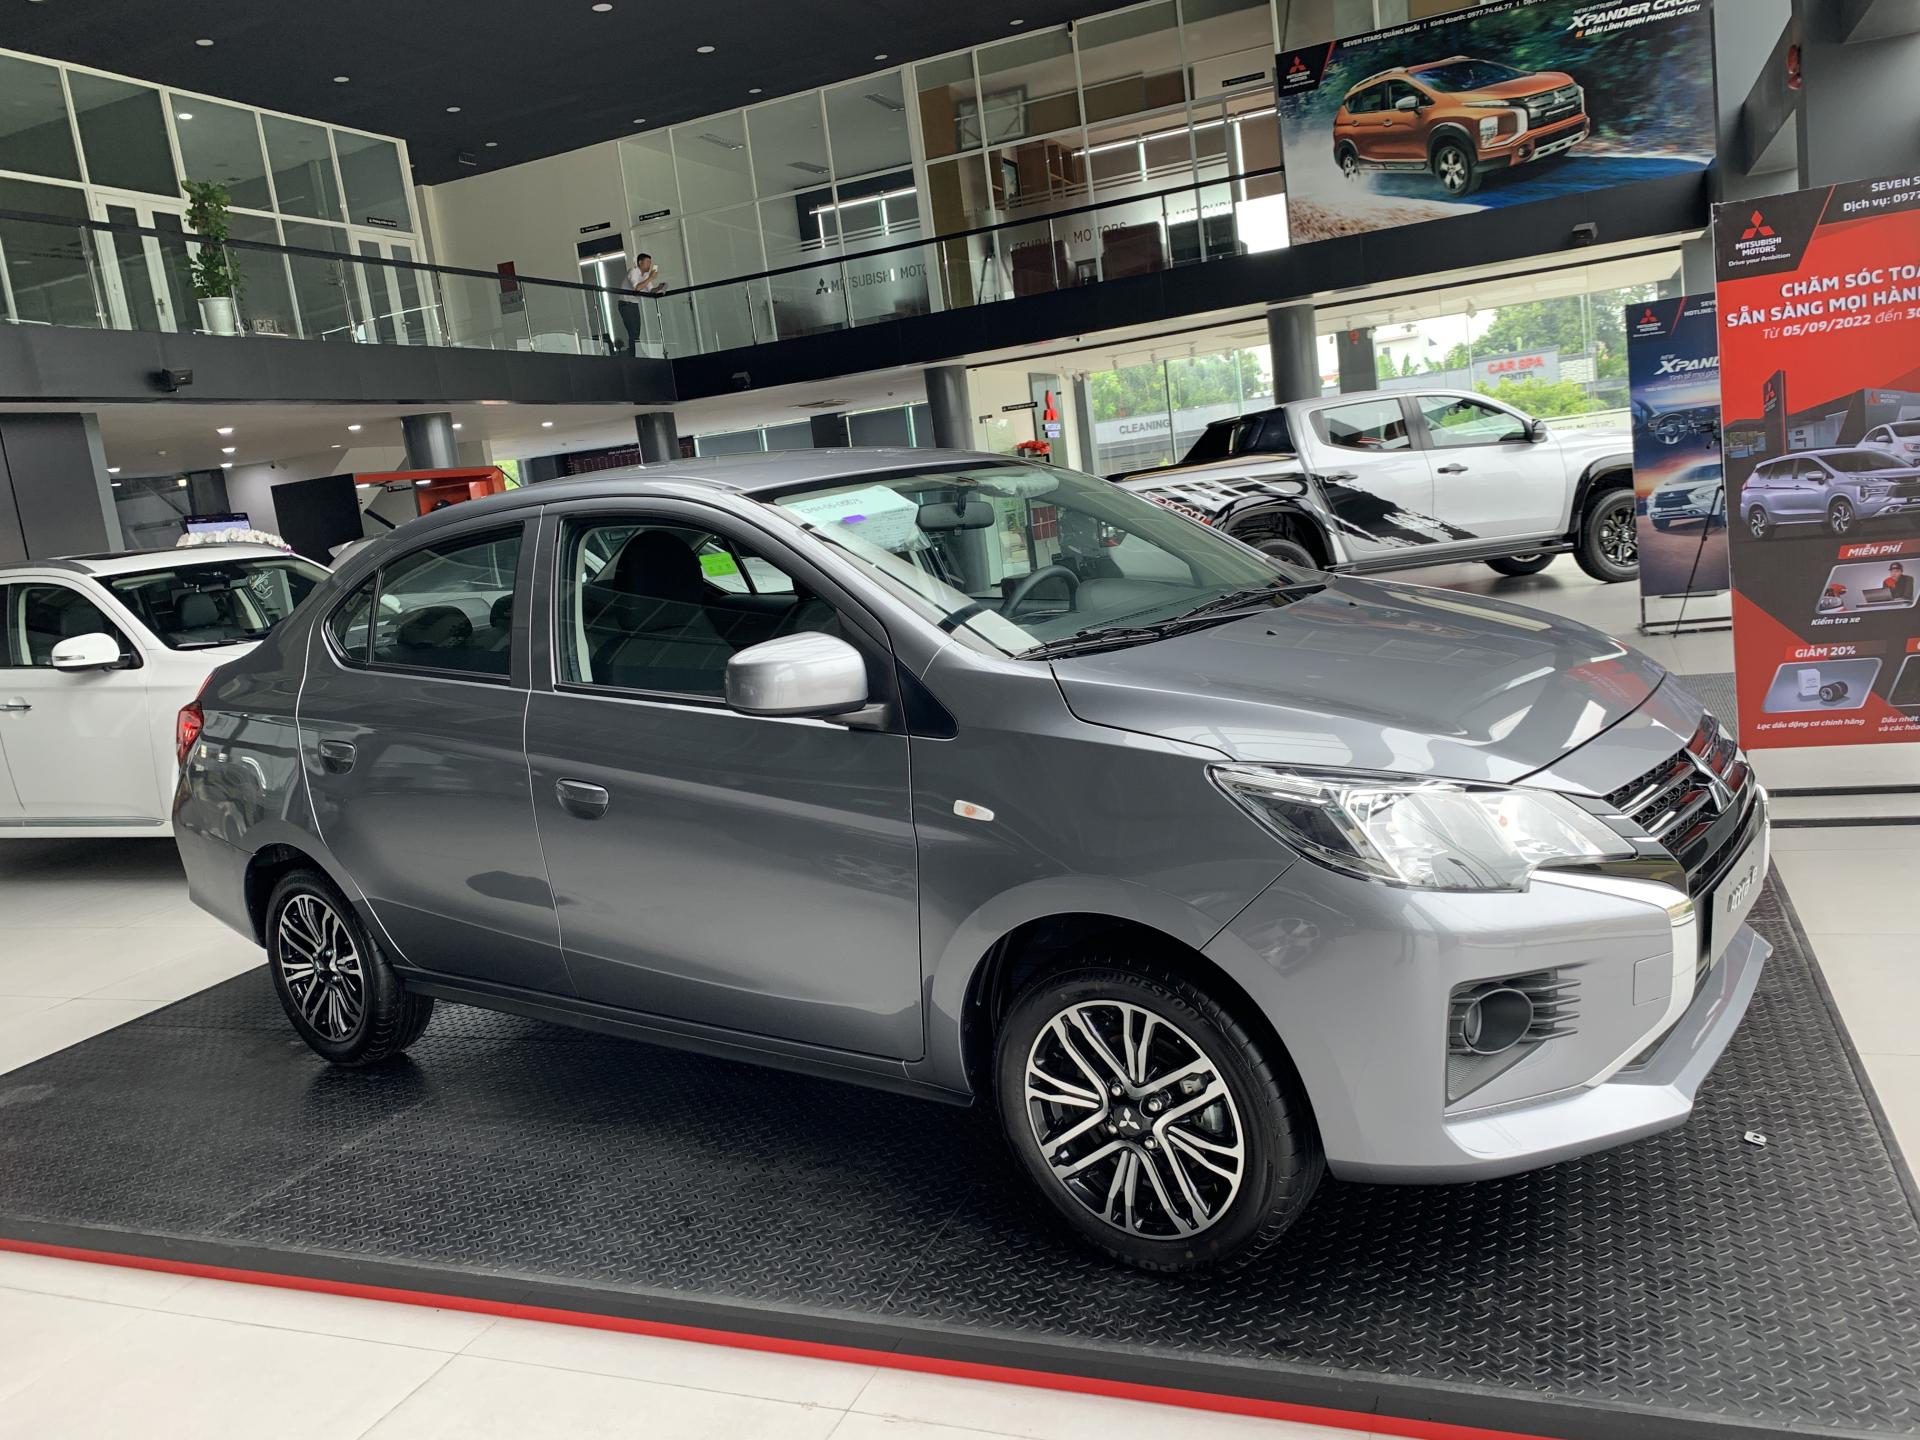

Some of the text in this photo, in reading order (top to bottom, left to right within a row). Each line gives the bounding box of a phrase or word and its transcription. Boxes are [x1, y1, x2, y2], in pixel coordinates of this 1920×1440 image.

[1566, 2, 1651, 31] XPANDER
[1646, 9, 1677, 22] PHONG
[1677, 3, 1702, 16] CÁCH
[1871, 177, 1911, 193] SEVEN
[1843, 199, 1869, 213] Dịch
[1872, 197, 1891, 208] vụ:
[1735, 237, 1782, 250] MITSUBISHI
[1742, 245, 1777, 256] MOTORS
[1728, 252, 1791, 267] Drive your Ambition
[1780, 276, 1839, 298] CHĂM
[1845, 267, 1884, 289] SÓC
[1725, 305, 1766, 328] SẴN
[1770, 300, 1824, 321] SÀNG
[1829, 293, 1867, 313] MỌI
[1762, 328, 1779, 340] Từ
[1783, 314, 1872, 338] 05/09/2022
[1875, 308, 1903, 324] đến
[1488, 356, 1544, 375] CAR SPA
[1119, 418, 1171, 435] CLEANING
[1847, 541, 1904, 558] MIỄN PHÍ
[1810, 616, 1861, 626] Kiểm tra xe
[1795, 644, 1857, 659] GIẢM 20%
[1756, 722, 1772, 731] Lọc
[1787, 720, 1809, 731] động
[1820, 718, 1843, 727] chính
[1878, 724, 1888, 733] và
